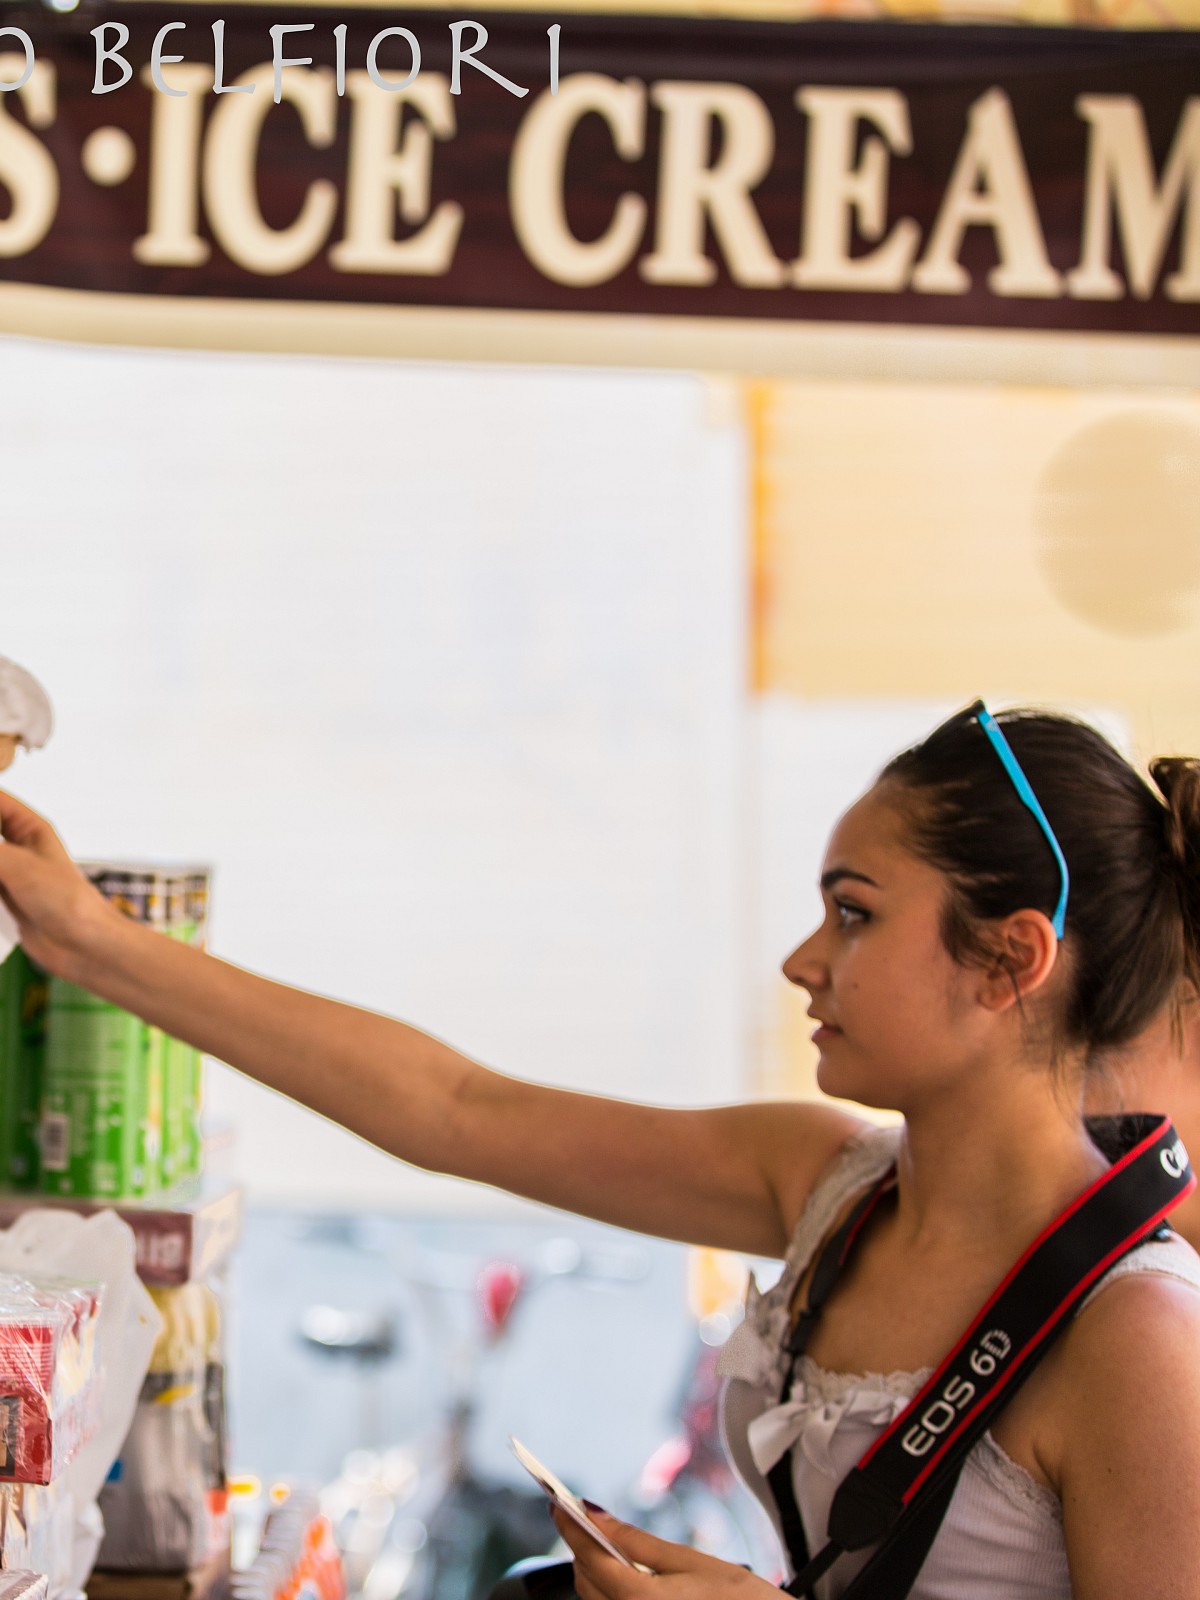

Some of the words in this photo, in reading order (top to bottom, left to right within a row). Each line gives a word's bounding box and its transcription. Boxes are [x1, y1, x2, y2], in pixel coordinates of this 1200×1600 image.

[509, 72, 1200, 300] CREAM
[902, 1375, 975, 1457] EOS
[970, 1328, 1012, 1376] 6D
